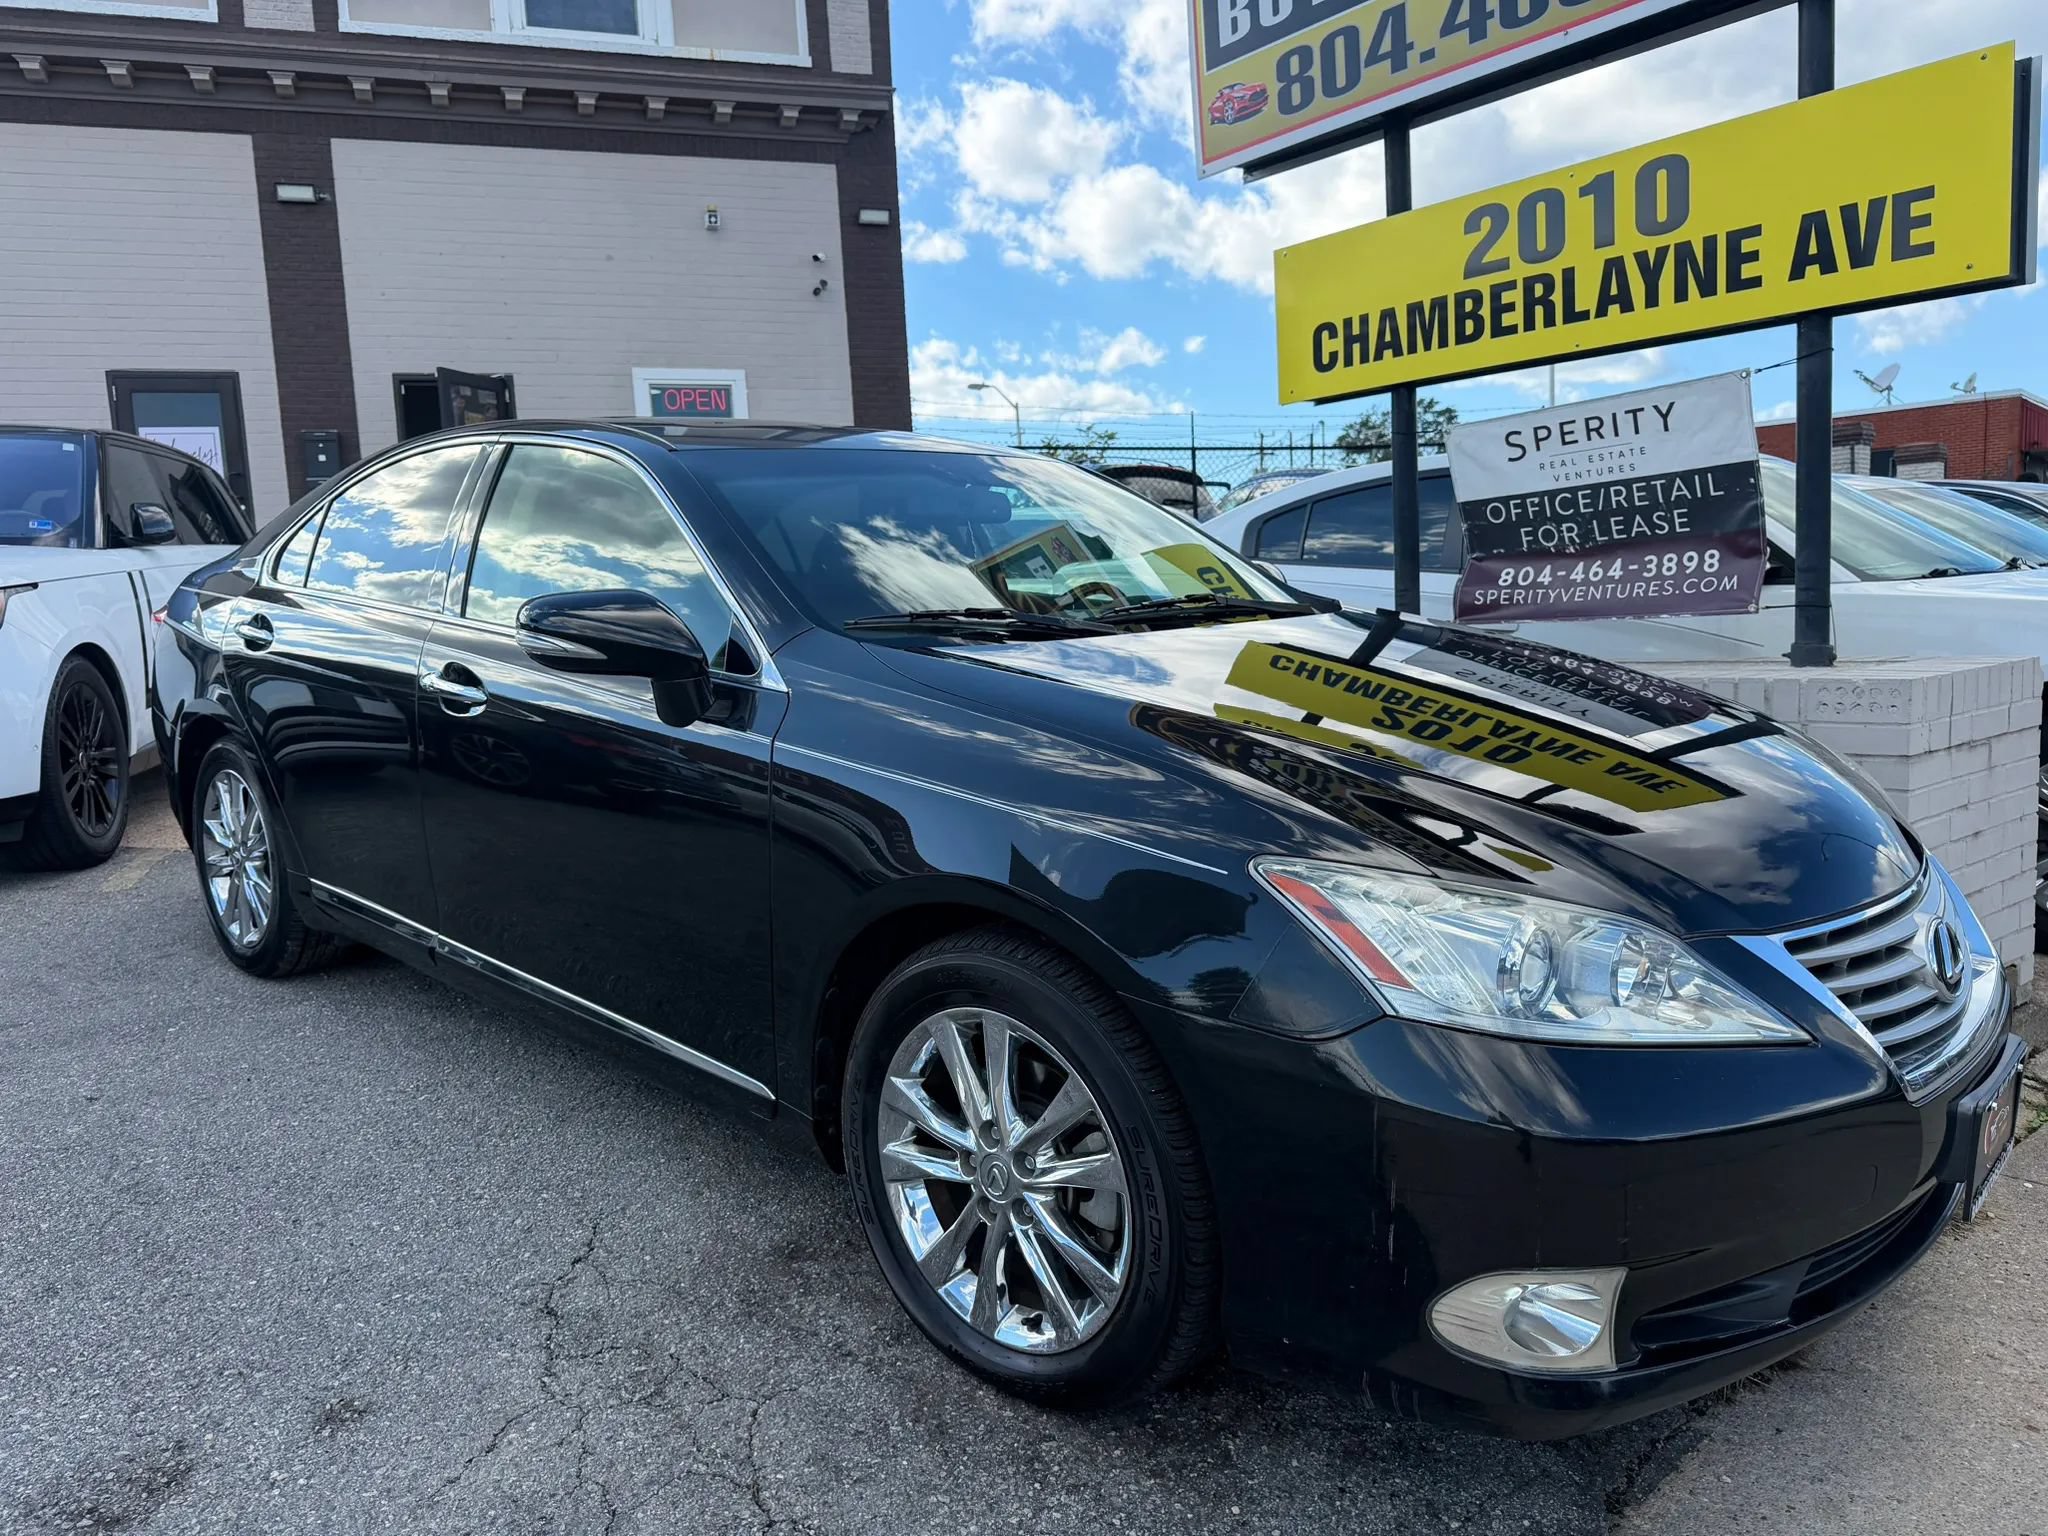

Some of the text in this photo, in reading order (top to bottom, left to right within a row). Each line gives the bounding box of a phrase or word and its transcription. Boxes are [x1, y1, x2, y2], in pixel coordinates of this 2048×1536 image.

[1275, 0, 1592, 117] 804.4
[1462, 153, 1690, 280] 2010
[1312, 184, 1936, 373] CHAMBERLAYNE AVE
[664, 388, 727, 411] OPEN
[1504, 401, 1676, 462] SPERITY
[1538, 445, 1648, 471] REAL ESTATE
[1552, 462, 1637, 483] VENTURES
[1486, 472, 1725, 525] OFFICE/RETAIL
[1520, 507, 1691, 550] FOR LEASE
[1498, 548, 1721, 587] 804-464-3898
[1474, 574, 1739, 606] SPERITYVENTURES.COM
